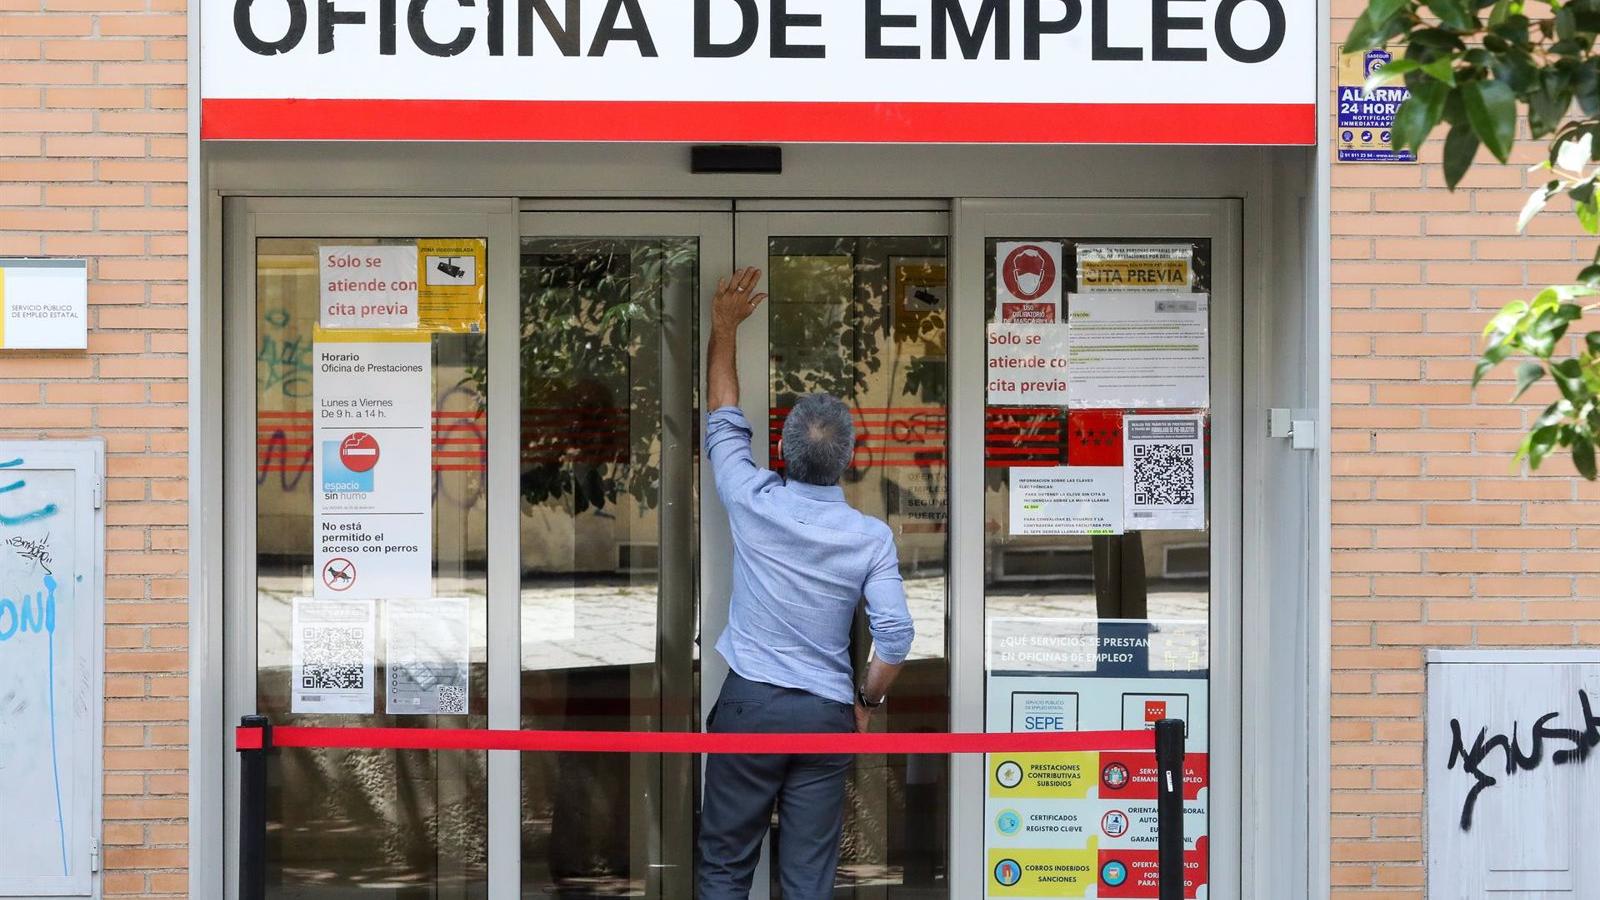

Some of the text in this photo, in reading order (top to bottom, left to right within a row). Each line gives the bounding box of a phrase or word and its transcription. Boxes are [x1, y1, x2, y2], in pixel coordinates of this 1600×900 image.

[234, 0, 1286, 63] OFICINA DE EMPLEO
[1341, 103, 1358, 114] 24
[327, 255, 382, 268] Solo se
[1086, 269, 1184, 283] CITA PREVIA
[328, 278, 418, 292] atiende con
[328, 302, 356, 316] cita
[361, 302, 409, 318] previa
[989, 332, 1041, 344] Solo se
[321, 352, 360, 361] Horario
[989, 355, 1045, 368] atiende
[1050, 358, 1067, 368] co
[321, 363, 423, 373] Oficina de Prestaciones
[989, 378, 1015, 391] cita
[1020, 378, 1067, 394] previa
[321, 398, 349, 407] Lunes
[359, 398, 393, 407] Viernes
[321, 409, 334, 418] De
[336, 409, 343, 418] 9
[345, 409, 353, 418] h.
[365, 409, 375, 418] 14
[378, 409, 387, 418] h.
[325, 481, 360, 492] espacio
[325, 490, 367, 500] sin humo
[322, 522, 362, 531] No está
[322, 533, 384, 543] permitido el
[322, 545, 418, 554] acceso con perros
[1030, 636, 1086, 647] SERVICIOS
[1103, 638, 1151, 648] PRESTAN
[1002, 652, 1134, 663] EN OFICINAS DE EMPLEO?
[1025, 716, 1064, 730] SEPE
